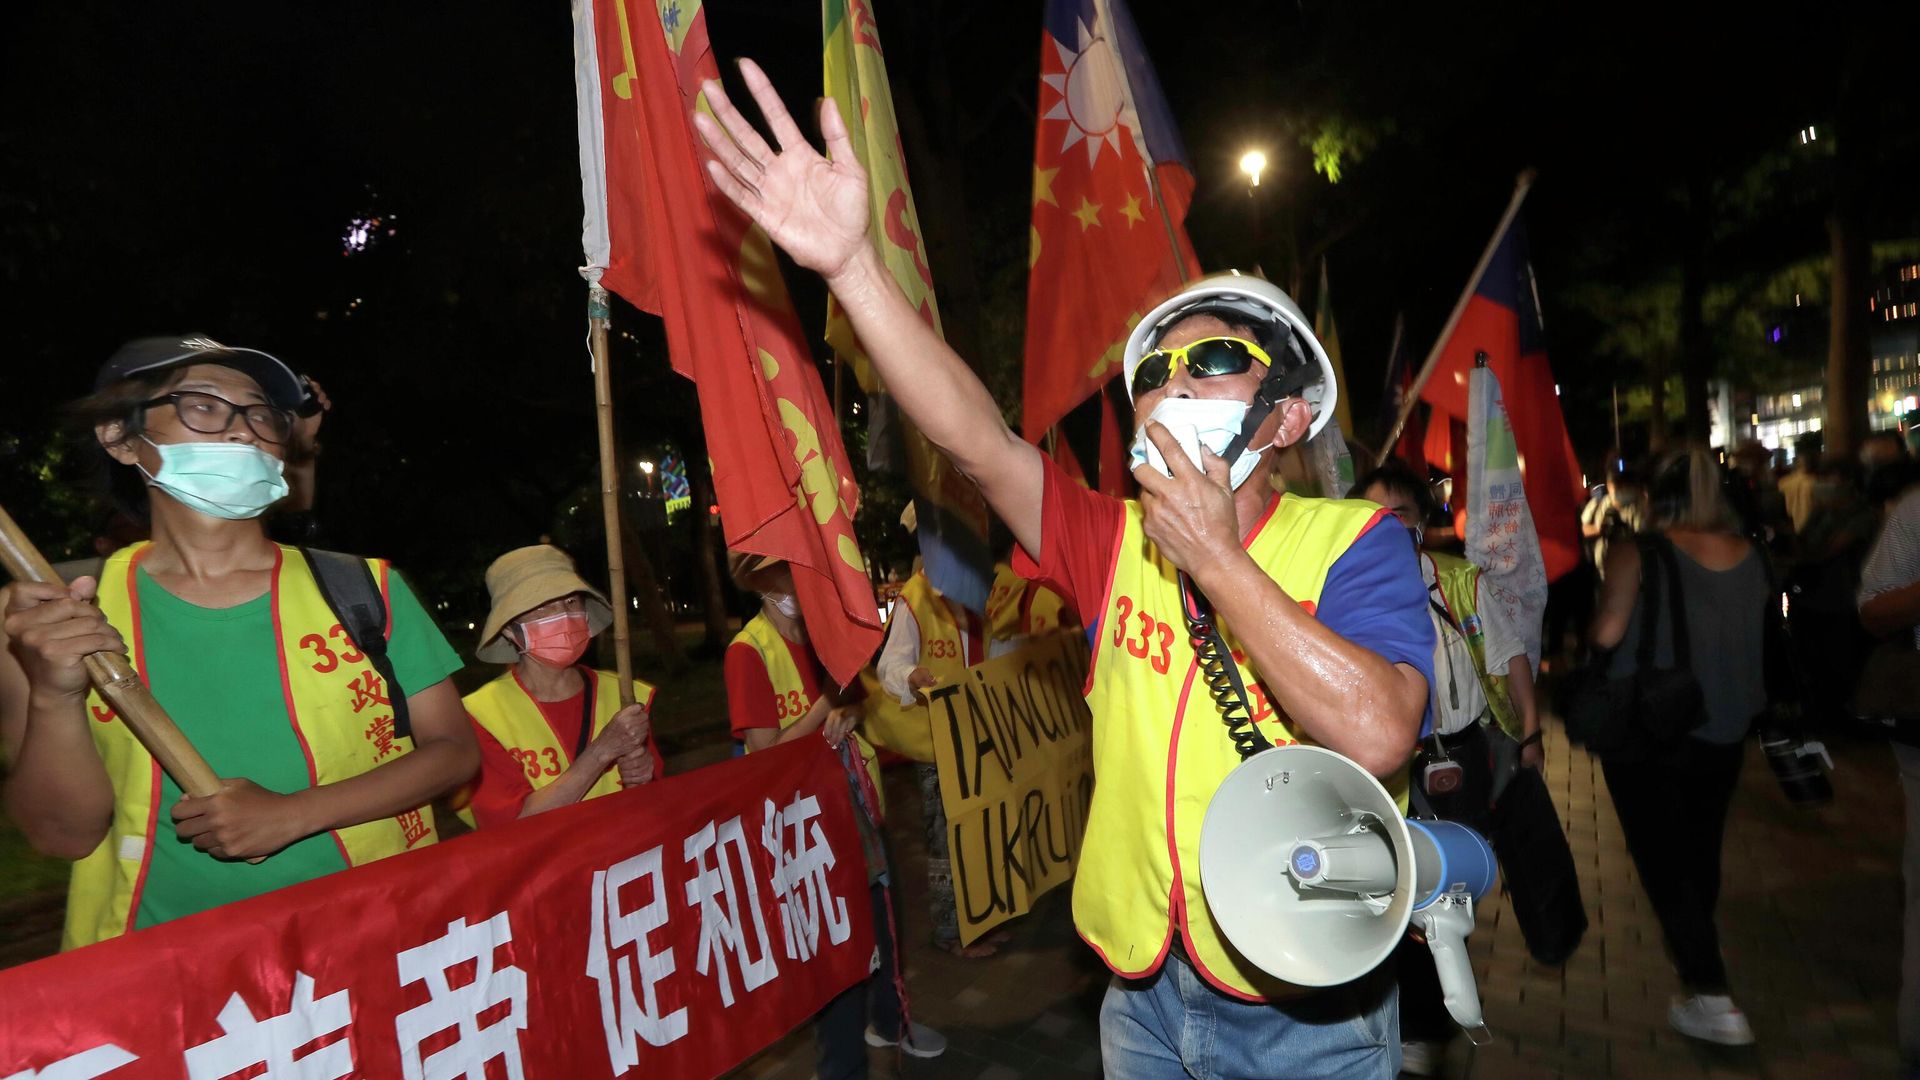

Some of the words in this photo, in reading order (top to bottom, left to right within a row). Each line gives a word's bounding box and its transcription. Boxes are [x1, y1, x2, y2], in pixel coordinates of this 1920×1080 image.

[927, 640, 957, 659] 333
[1113, 596, 1175, 675] 333
[775, 690, 811, 719] 33
[347, 670, 431, 849] 政黨盟
[585, 790, 851, 1077] 促和統
